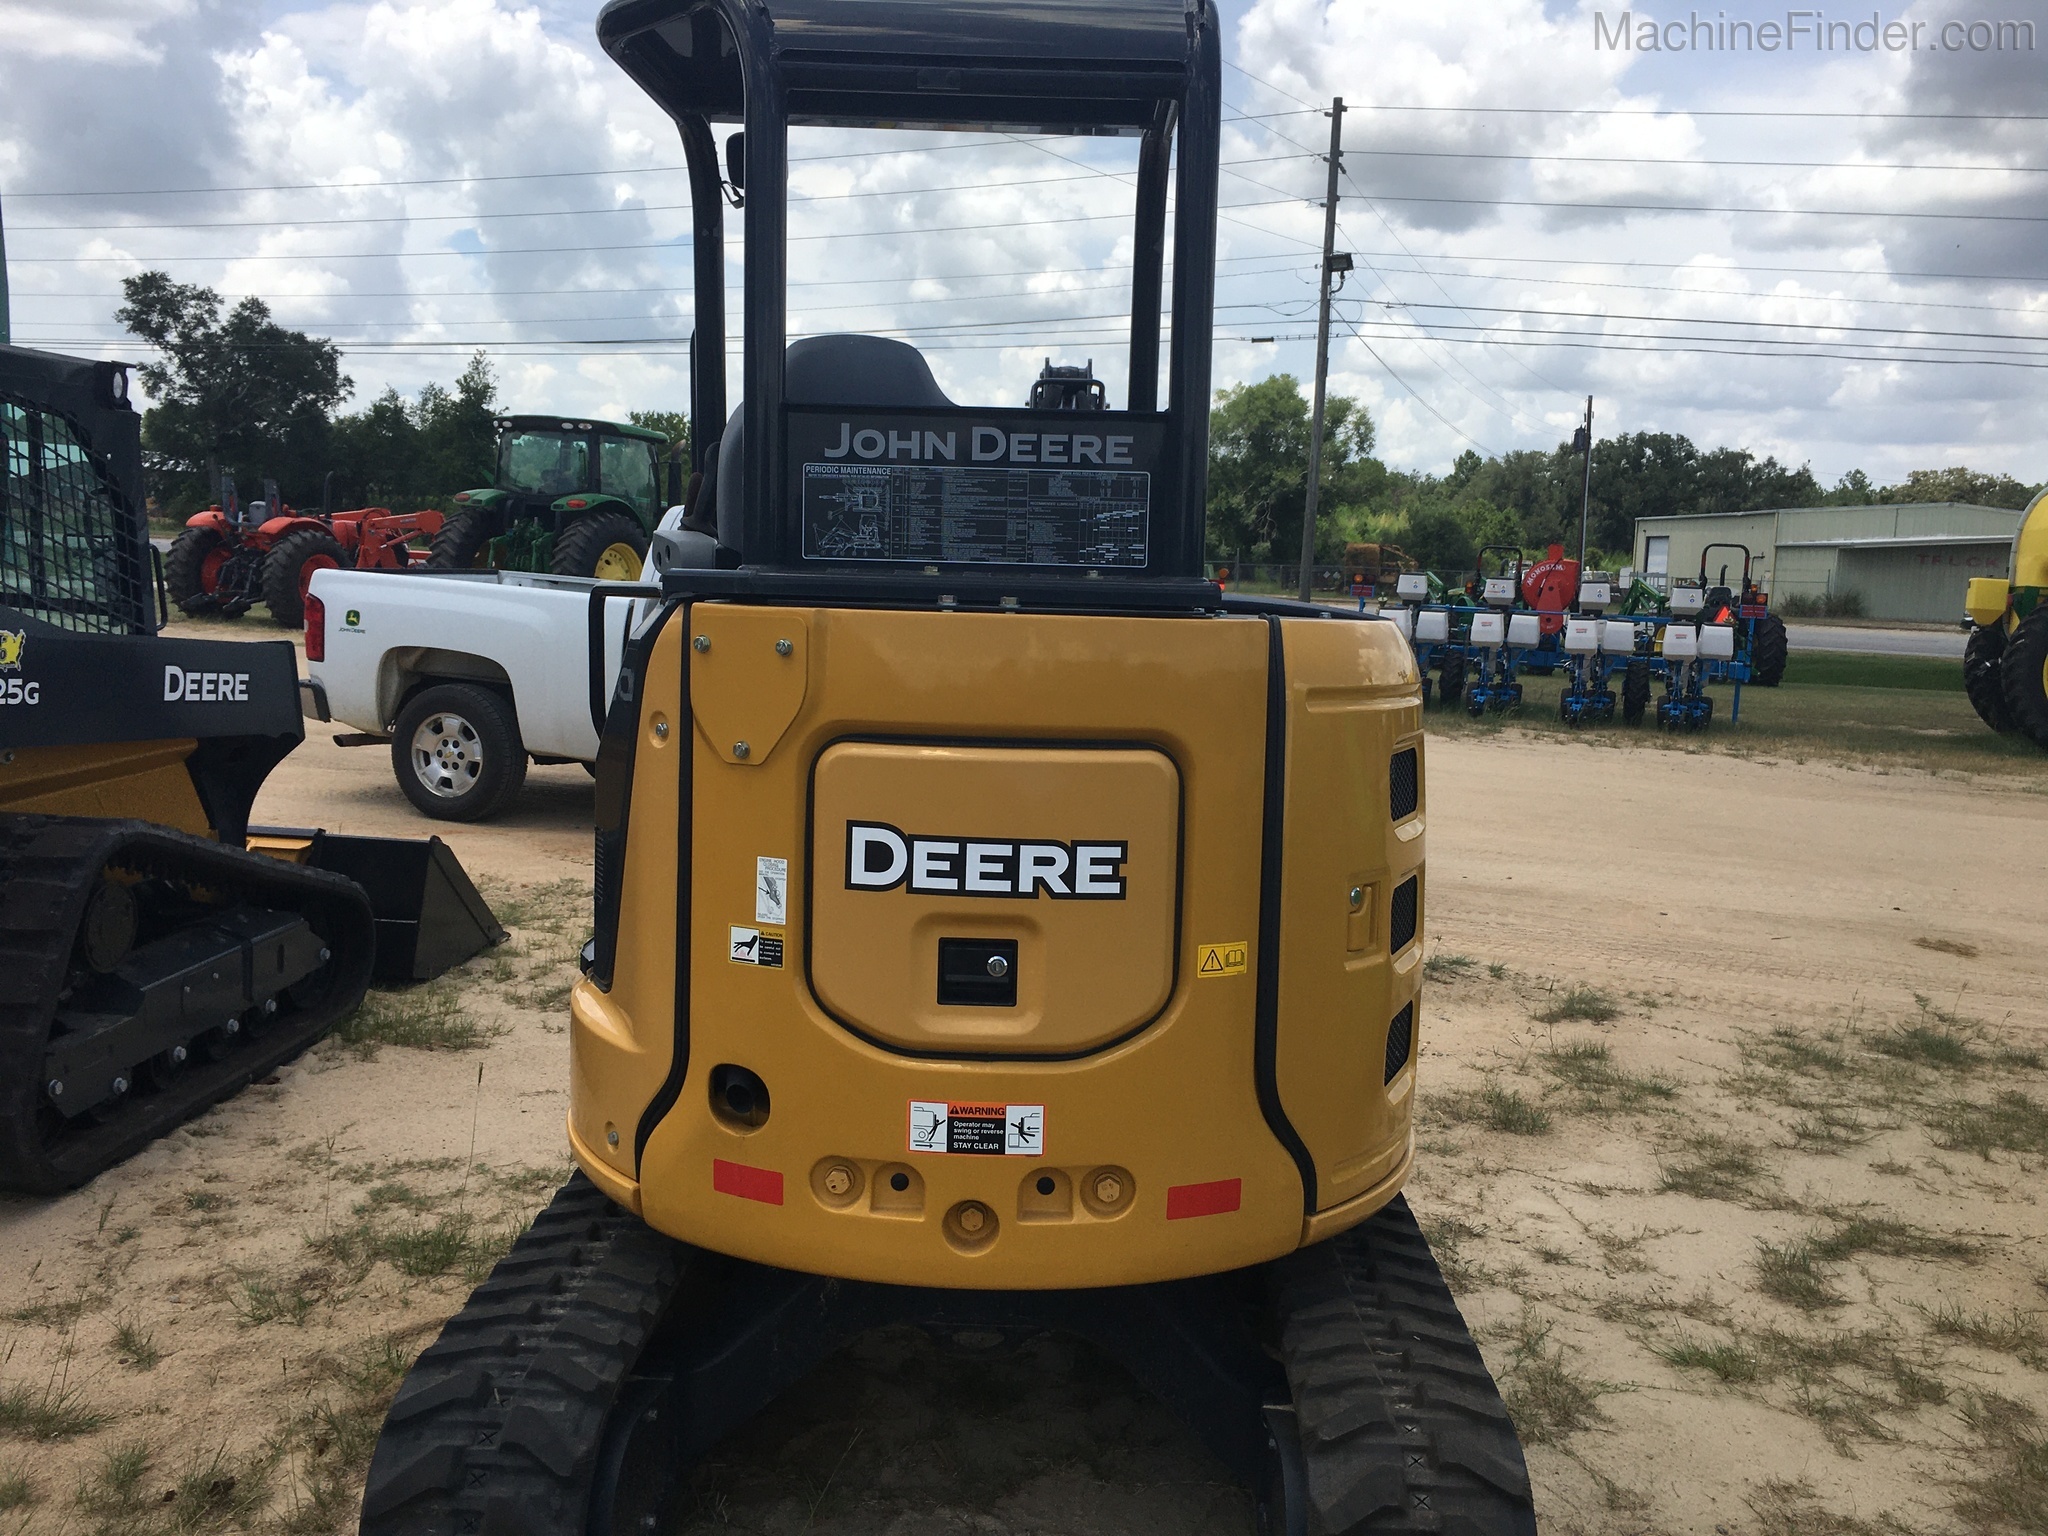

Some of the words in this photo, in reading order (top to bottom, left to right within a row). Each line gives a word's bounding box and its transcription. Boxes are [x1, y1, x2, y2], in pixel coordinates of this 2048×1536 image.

[824, 422, 956, 461] JOHN
[971, 426, 1134, 465] DEERE
[806, 466, 839, 474] PERIODIC
[840, 466, 892, 475] MAINTENANCE
[164, 665, 250, 701] DEERE
[849, 824, 1123, 896] DEERE
[959, 1106, 1005, 1116] WARNING
[953, 1120, 981, 1128] Operator
